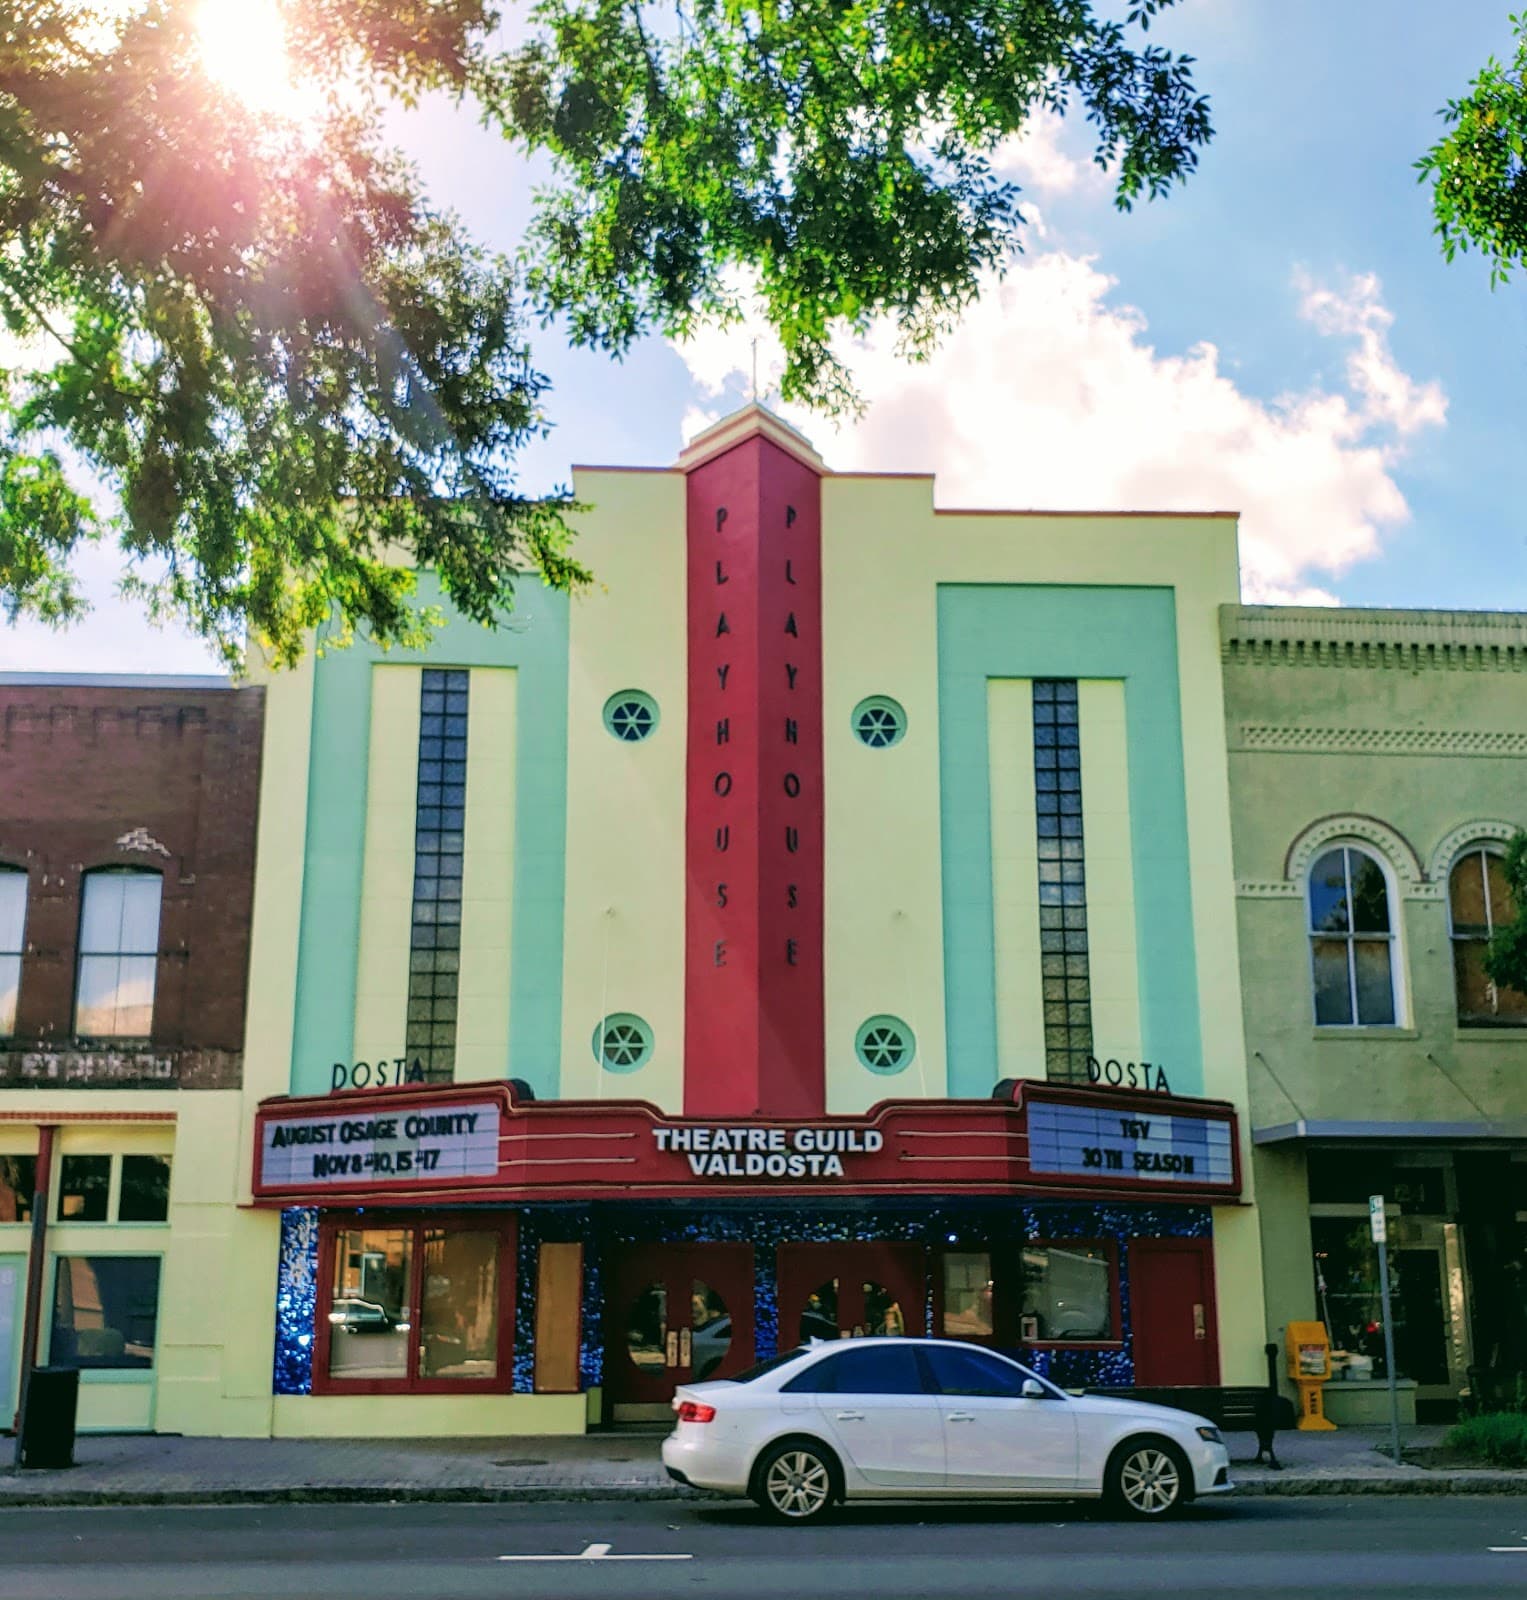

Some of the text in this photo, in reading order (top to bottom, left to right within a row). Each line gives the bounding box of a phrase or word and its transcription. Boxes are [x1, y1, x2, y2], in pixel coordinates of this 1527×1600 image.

[714, 507, 732, 966] PLAYHOUSE
[784, 505, 801, 966] PLAYHOUSE
[331, 1056, 425, 1089] DOSTA
[1086, 1056, 1171, 1094] DOSTA
[271, 1112, 479, 1148] AUGUST OSAGE COUNTY
[652, 1129, 884, 1153] THEATRE GUILD
[313, 1152, 351, 1178] NOV
[688, 1154, 844, 1177] VALDOSTA
[1133, 1151, 1194, 1173] SEASON
